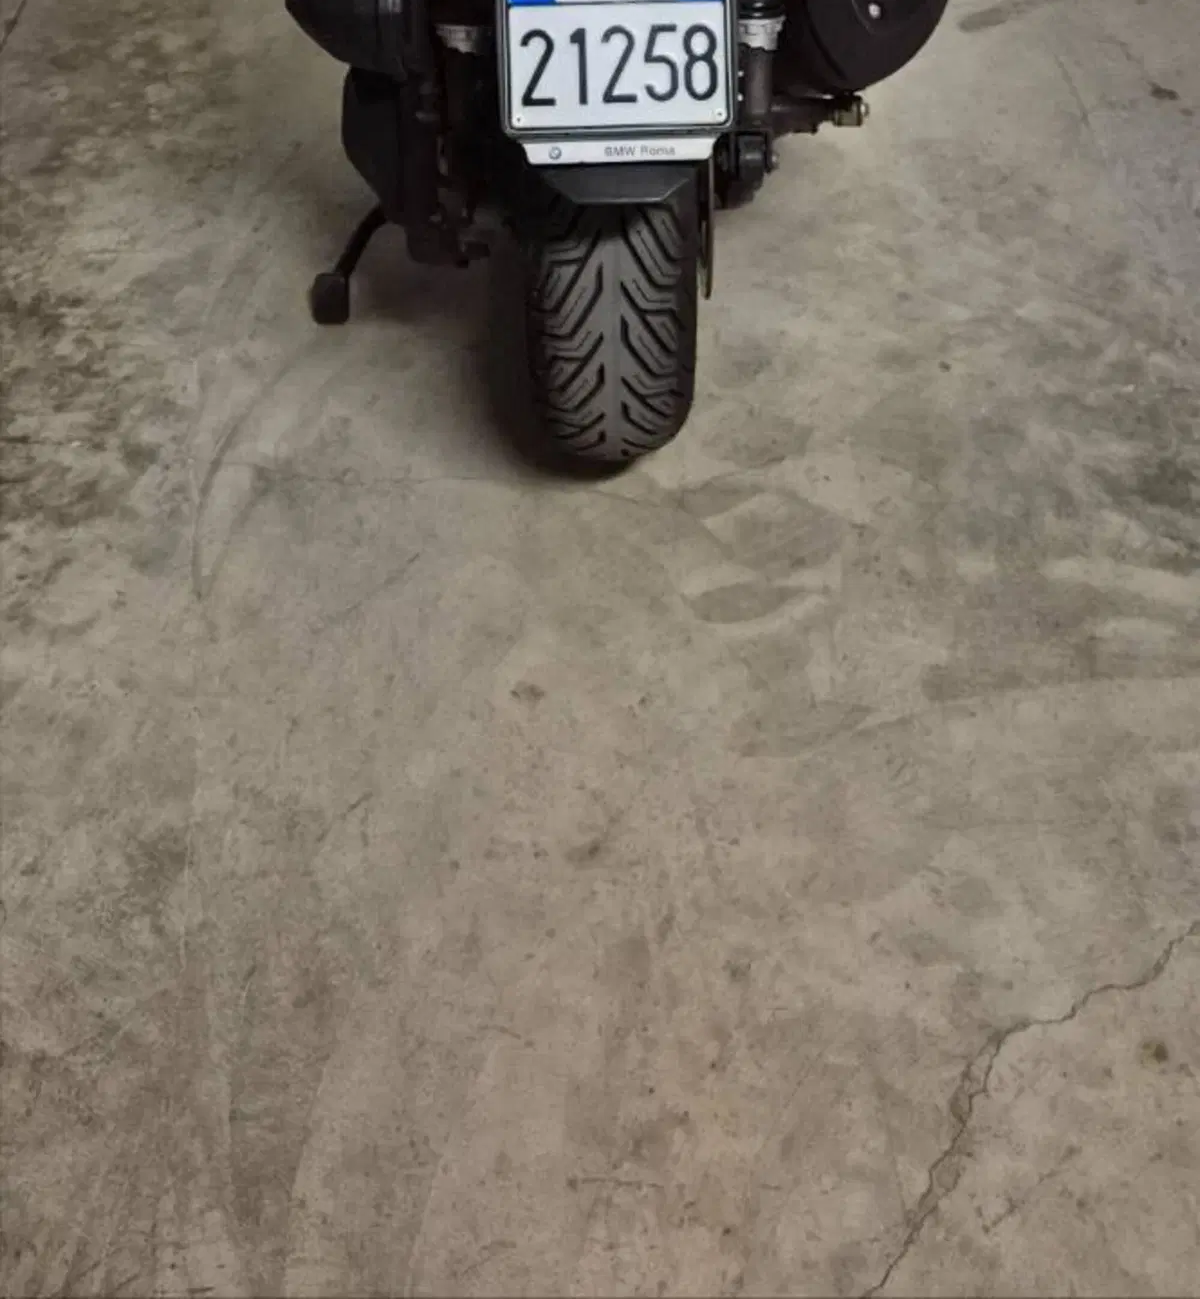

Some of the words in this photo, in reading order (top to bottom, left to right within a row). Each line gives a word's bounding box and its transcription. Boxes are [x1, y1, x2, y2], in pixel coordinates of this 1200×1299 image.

[519, 23, 719, 107] 21258
[604, 146, 636, 157] BMW
[640, 145, 676, 156] Roma
